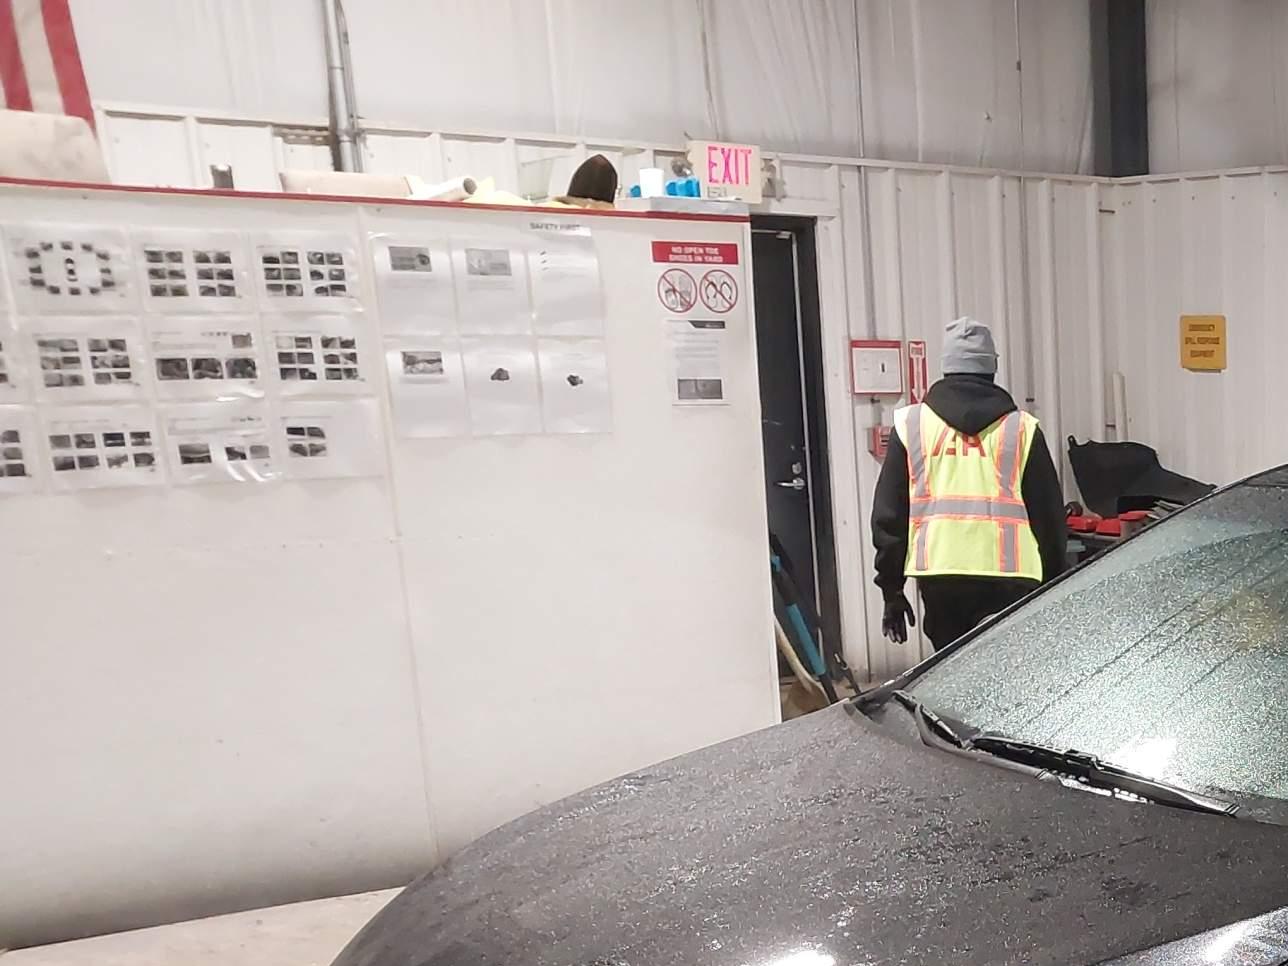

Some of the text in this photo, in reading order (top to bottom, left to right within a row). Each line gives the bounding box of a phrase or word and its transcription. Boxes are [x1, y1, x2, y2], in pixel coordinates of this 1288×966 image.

[707, 146, 752, 185] EXIT
[529, 222, 558, 230] SAFETY
[671, 246, 682, 254] NO
[683, 246, 704, 254] OPEN
